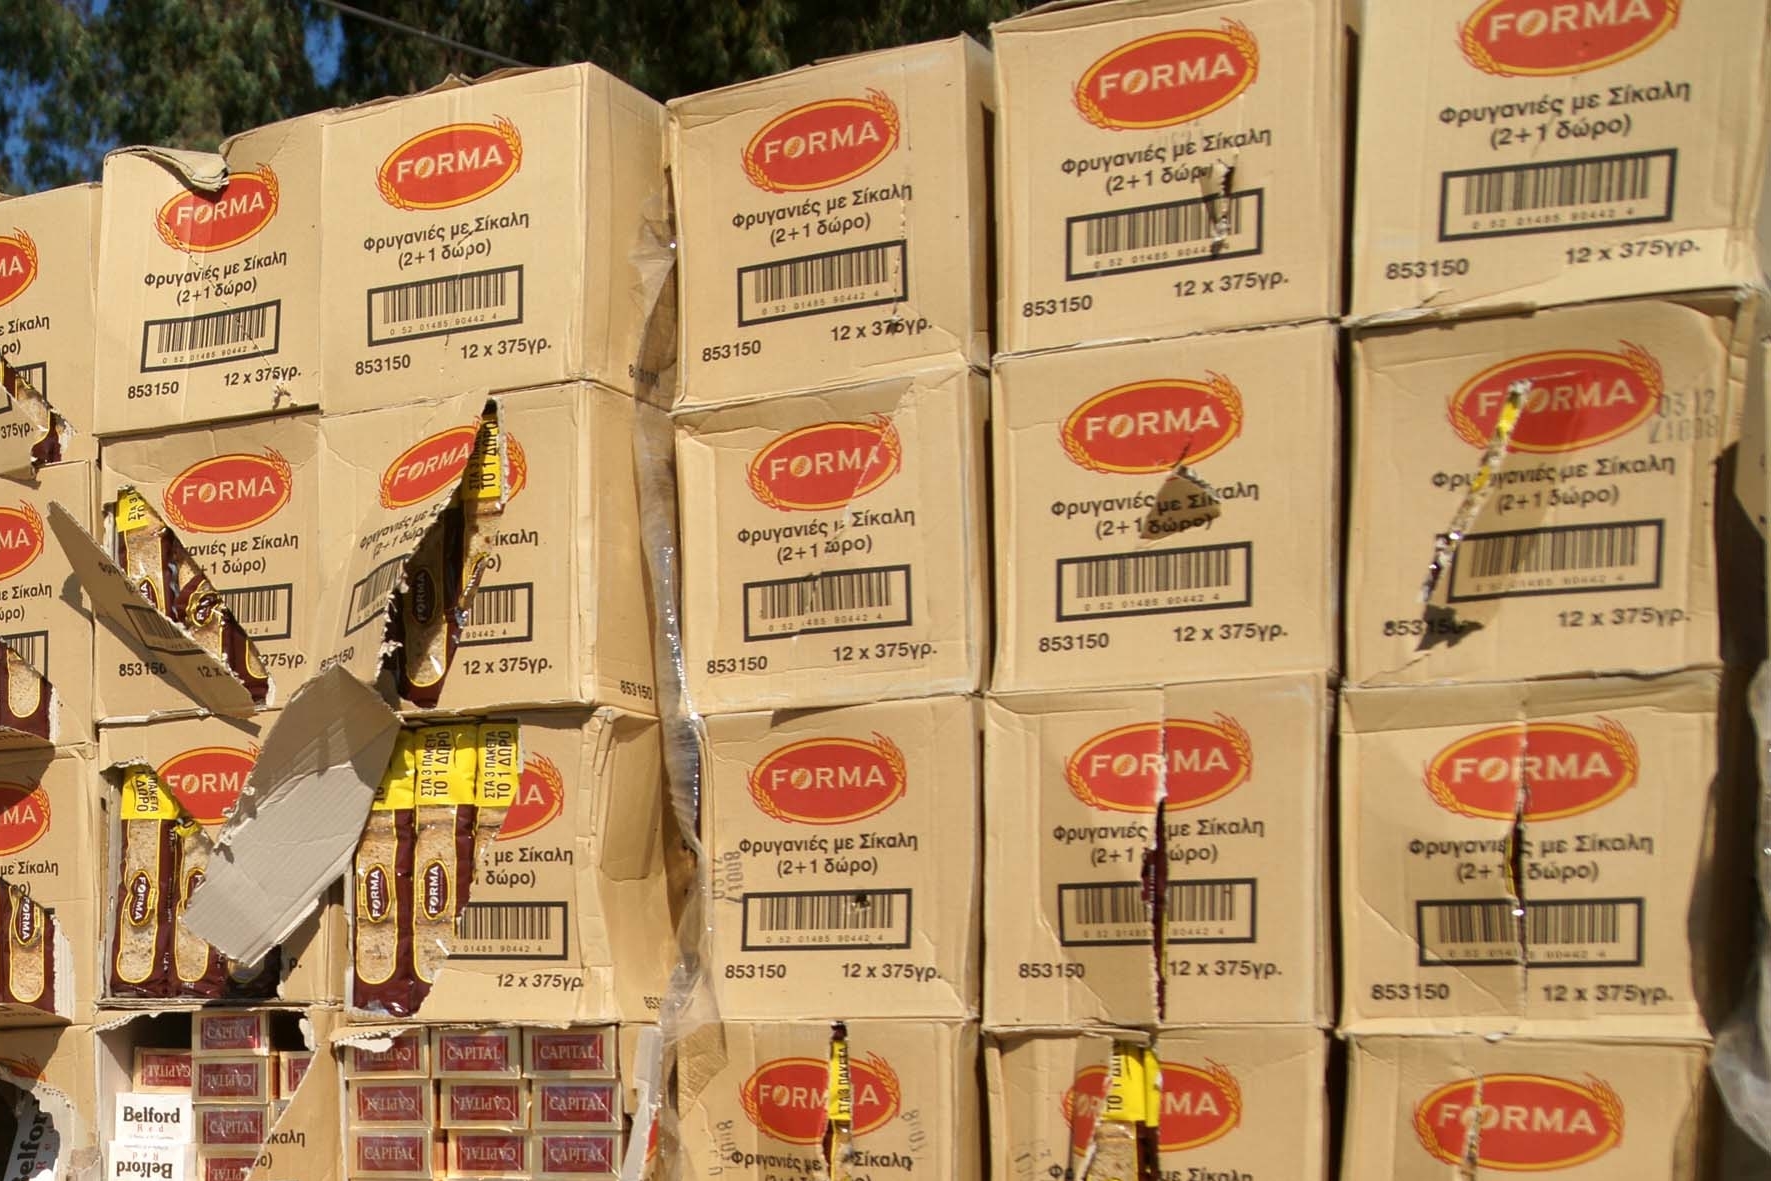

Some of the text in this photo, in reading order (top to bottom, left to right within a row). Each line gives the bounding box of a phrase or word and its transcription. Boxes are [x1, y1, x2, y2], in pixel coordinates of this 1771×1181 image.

[1487, 0, 1653, 42] FORMA
[1098, 53, 1235, 100] FORMA
[1438, 80, 1691, 127] Φρυγανιές με Σίκαλη
[1555, 113, 1632, 143] δώρο)
[764, 120, 880, 163] FORMA
[1061, 127, 1271, 175] Φρυγανιές με Σίκαλη
[397, 146, 503, 183] FORMA
[176, 192, 265, 225] FORMA
[732, 183, 913, 230] Φρυγανιές με Σίκαλη
[363, 212, 529, 252] Φρυγανιές με Σίκαλη
[442, 240, 491, 261] δώρο)
[1385, 258, 1469, 280] 853150
[214, 279, 257, 298] δώρο)
[1173, 280, 1196, 297] 12
[460, 345, 478, 358] 12
[702, 340, 762, 361] 853150
[355, 355, 411, 375] 853150
[127, 381, 179, 399] 853150
[1084, 405, 1220, 439] FORMA
[182, 476, 276, 503] FORMA
[1038, 632, 1110, 652] 853150
[463, 661, 480, 675] 12
[423, 734, 436, 767] ΠΑΚΕΤΑ
[436, 731, 450, 764] ΔΩΡΟ
[486, 731, 496, 767] ΠΑΚΕΤΑ
[499, 731, 511, 766] ΔΩΡΟ
[421, 776, 432, 796] ΣΤΑ
[434, 781, 448, 796] ΤΟ
[485, 777, 494, 798] ΣΤΑ
[771, 766, 887, 790] FORMA
[497, 783, 510, 799] ΤΟ
[738, 831, 918, 855] Φρυγανιές με Σίκαλη
[429, 866, 438, 913] FORMA
[725, 964, 787, 980] 853150
[841, 965, 862, 978] 12
[1371, 984, 1449, 999] 853150
[447, 1047, 500, 1059] CAPITAL
[540, 1046, 595, 1058] CAPITAL
[123, 1106, 180, 1123] Belford
[210, 1121, 255, 1133] CAPITAL
[116, 1161, 172, 1179] Belford
